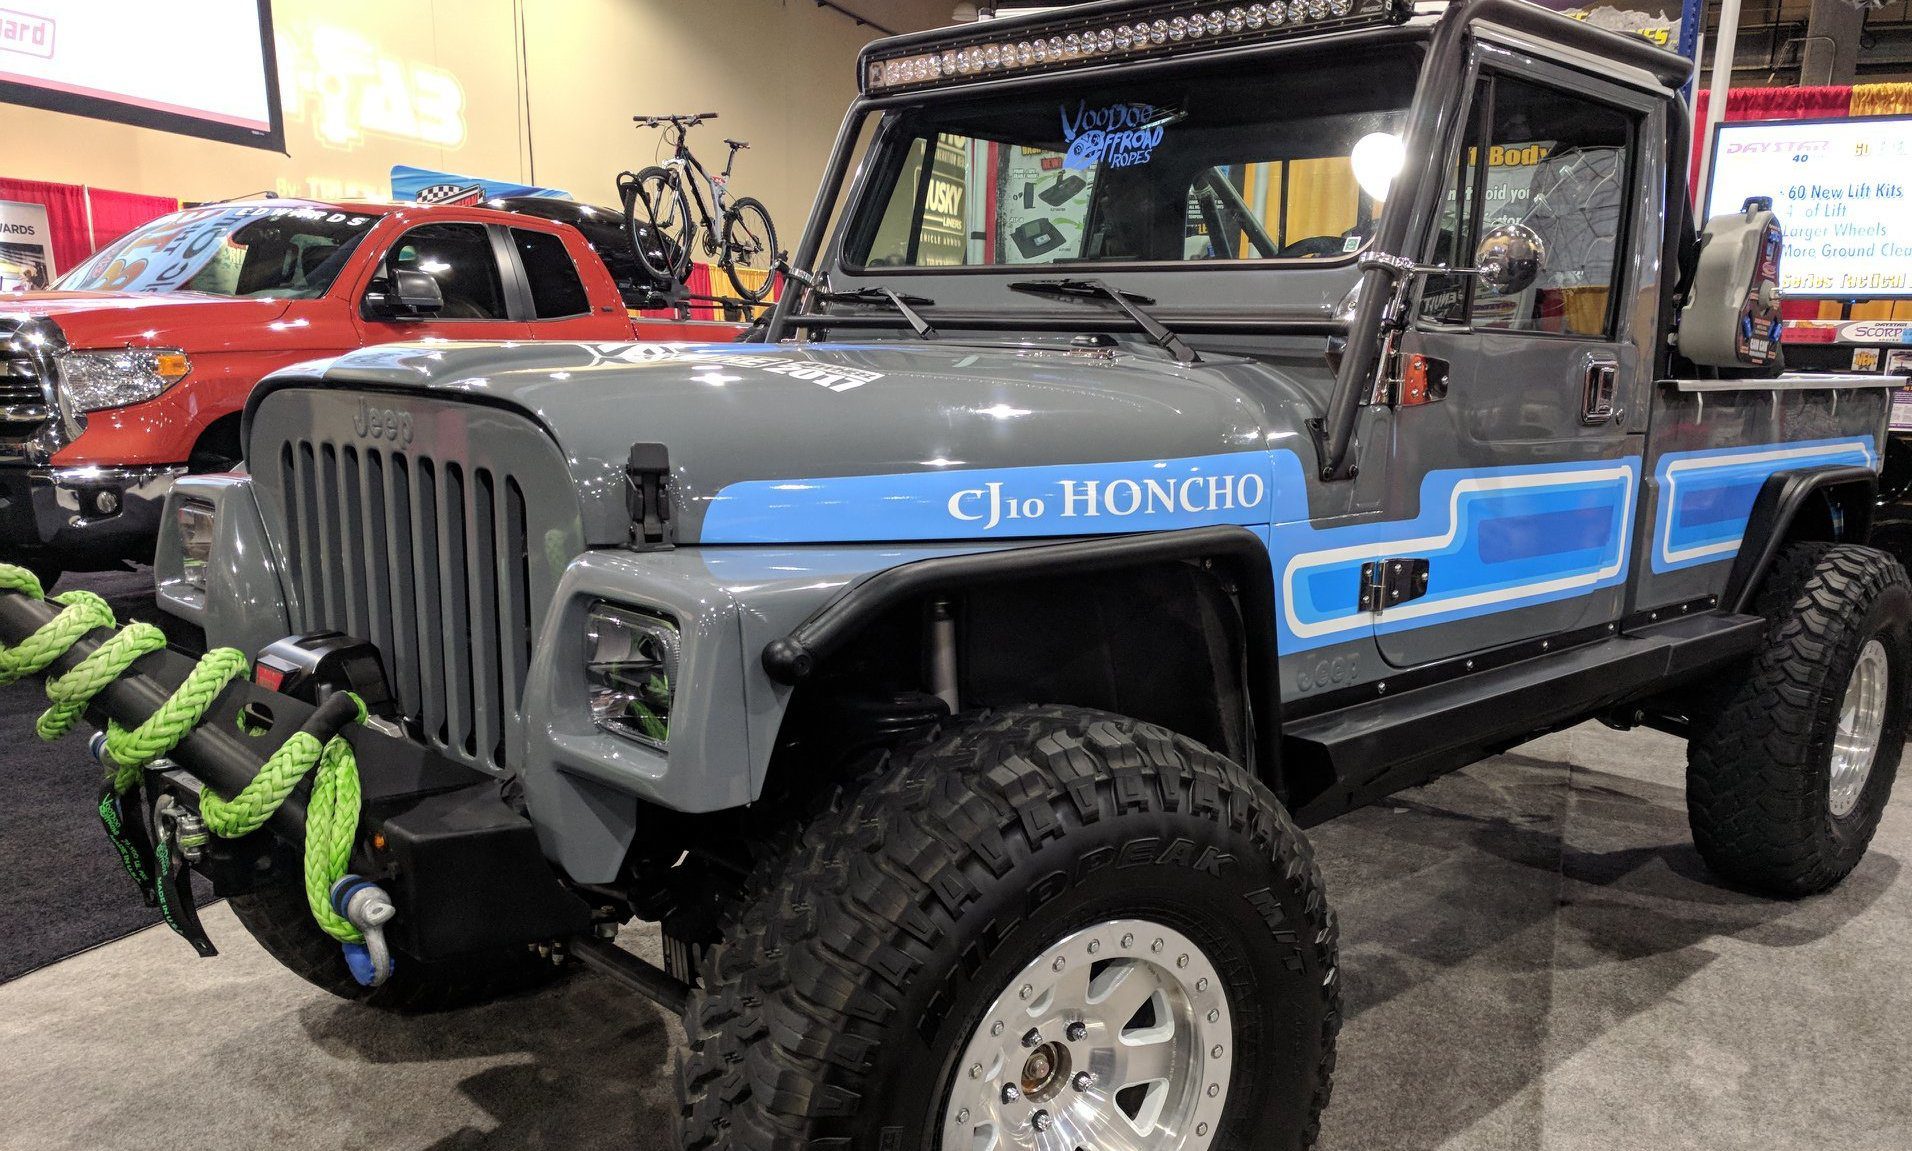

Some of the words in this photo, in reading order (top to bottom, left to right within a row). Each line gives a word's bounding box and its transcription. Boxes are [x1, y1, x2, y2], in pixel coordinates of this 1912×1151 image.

[0, 18, 46, 46] ard
[1060, 99, 1154, 142] VOODOO
[1726, 140, 1830, 155] DAYSTAR
[1110, 148, 1153, 169] ROPES
[1792, 154, 1809, 163] 40
[1788, 185, 1806, 200] 60
[1810, 185, 1843, 200] New
[1847, 182, 1871, 199] Lift
[1876, 182, 1904, 198] Kits
[1805, 202, 1820, 218] of
[1824, 202, 1847, 218] Lift
[0, 224, 36, 236] ARDS
[1783, 223, 1828, 241] Larger
[1834, 222, 1887, 239] Wheels
[1783, 244, 1816, 258] More
[1822, 242, 1875, 258] Ground
[353, 396, 414, 451] Jeep
[947, 481, 1045, 530] CJ10
[1059, 473, 1264, 517] HONCHO
[157, 876, 167, 905] MADE
[162, 904, 171, 916] IN
